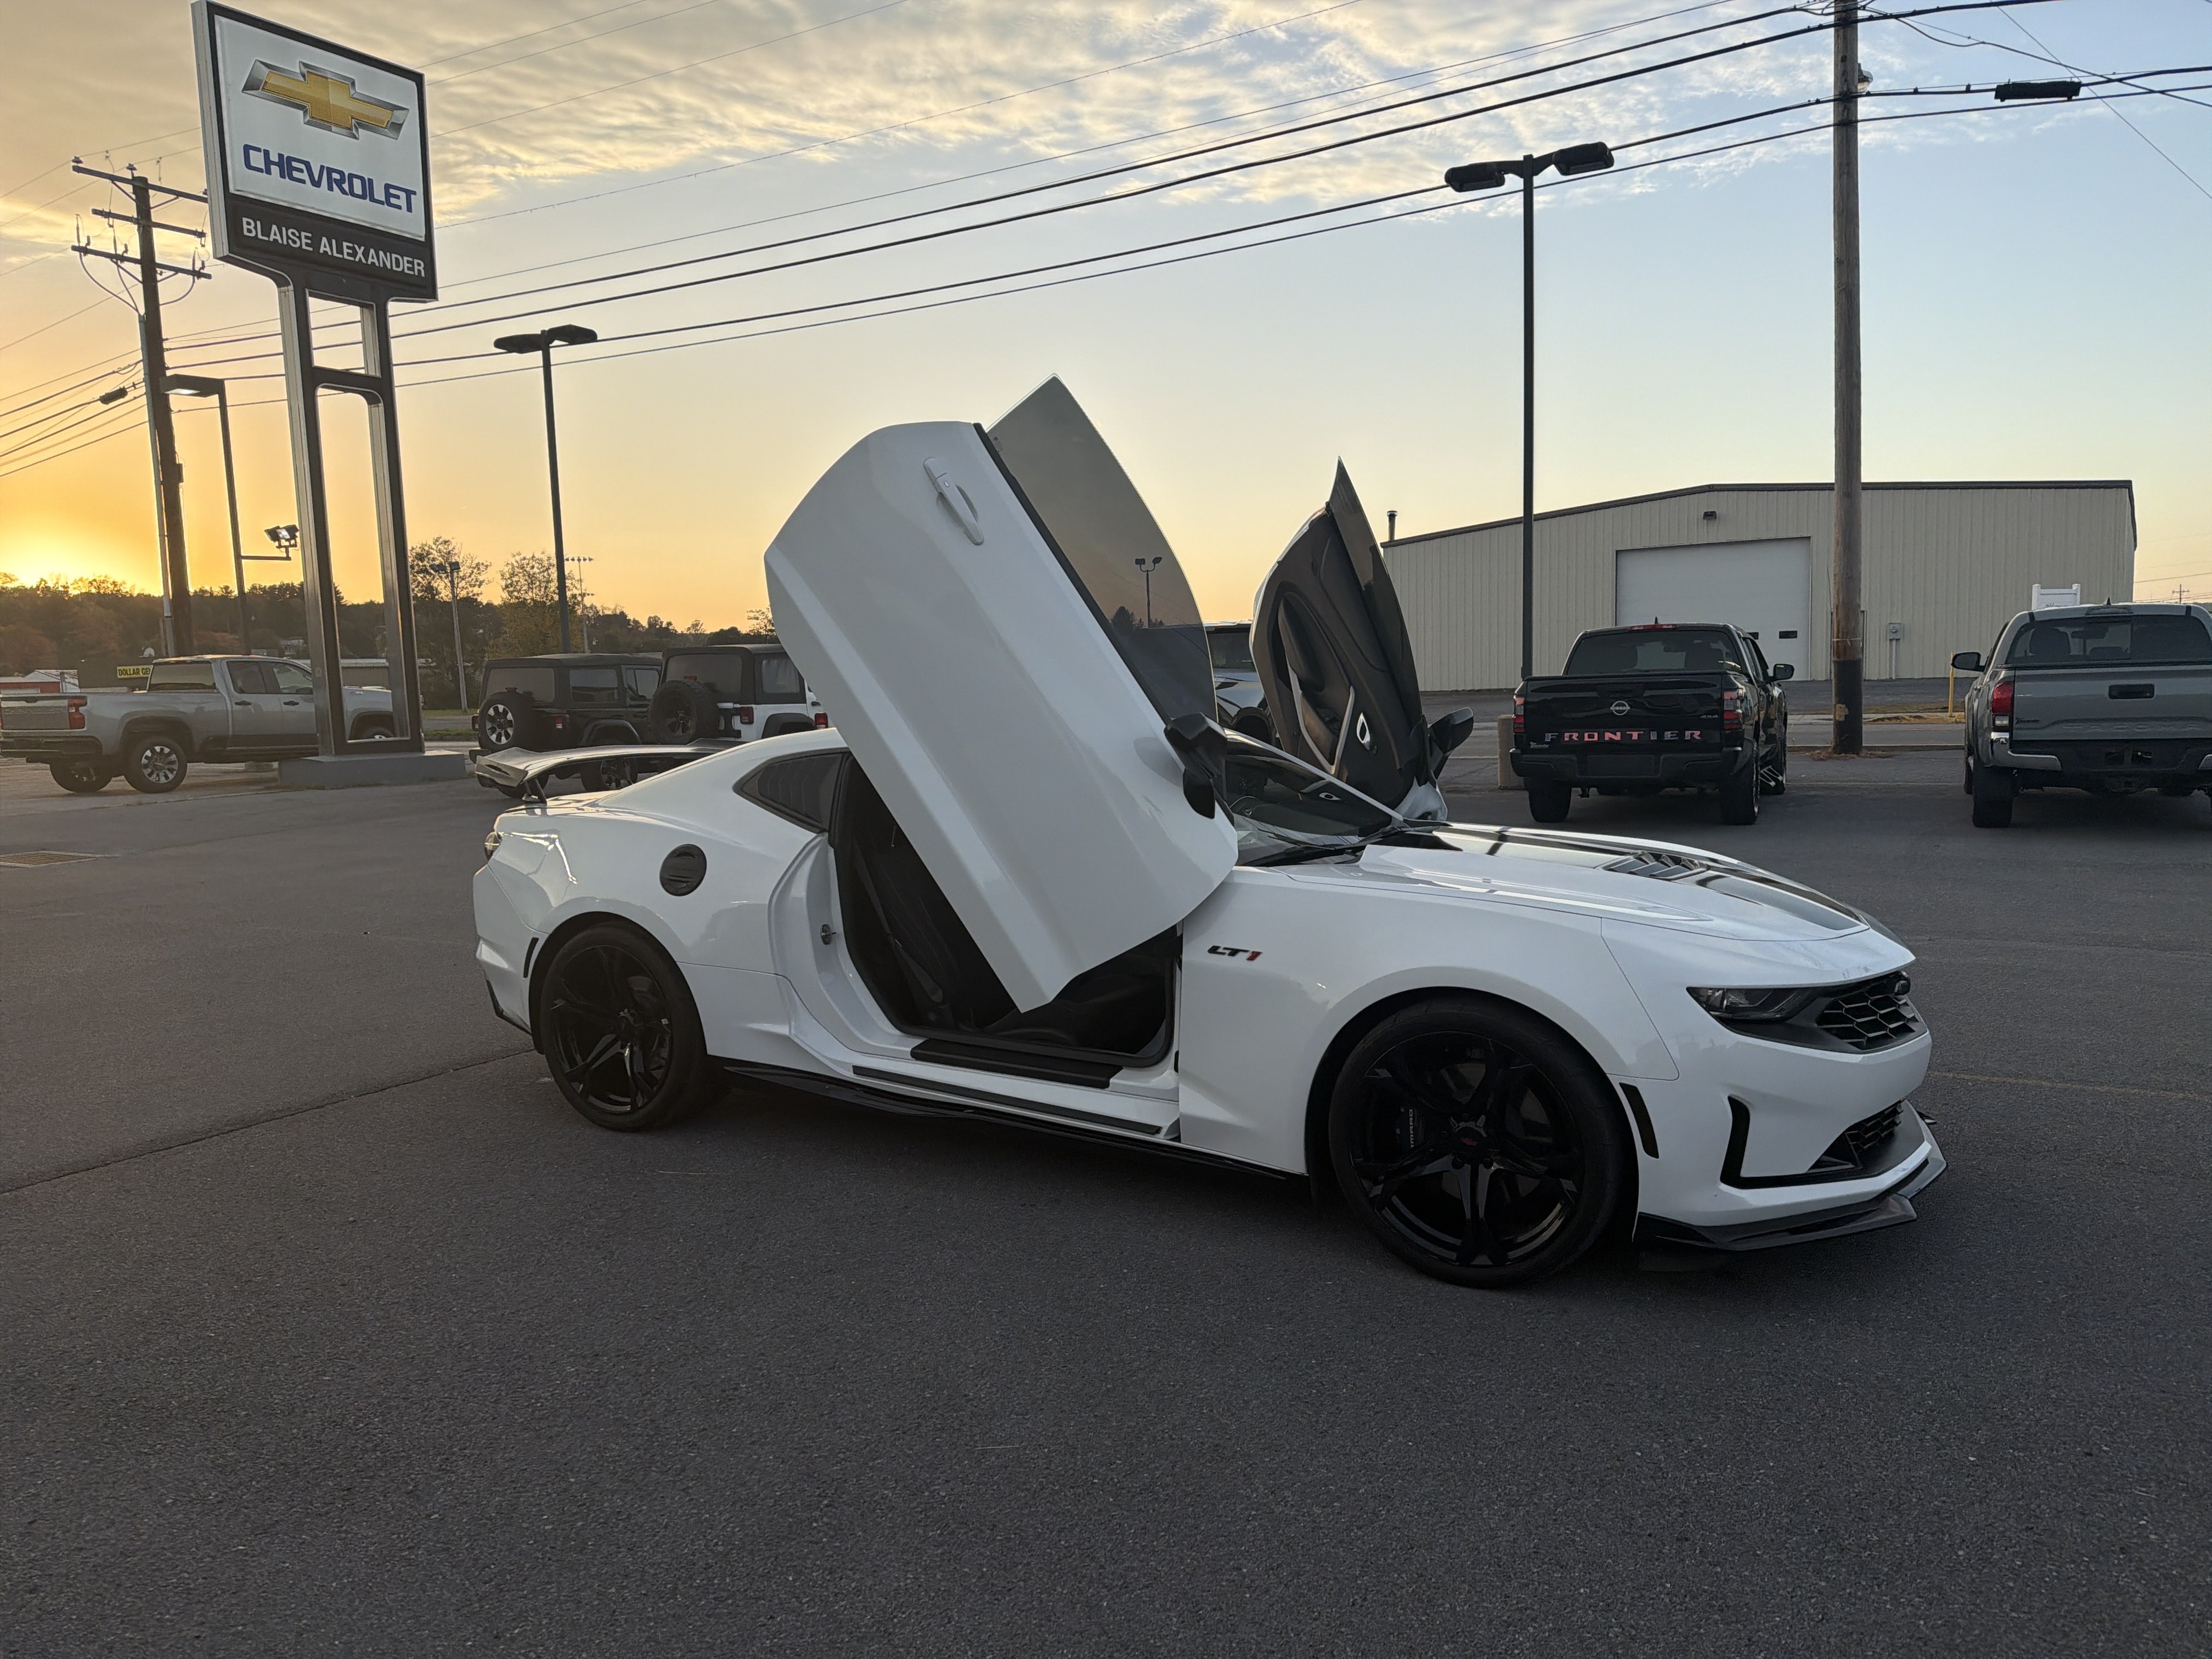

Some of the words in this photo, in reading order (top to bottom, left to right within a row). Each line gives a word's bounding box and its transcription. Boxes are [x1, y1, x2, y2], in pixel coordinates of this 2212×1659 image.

[242, 143, 417, 213] CHEVROLET
[242, 217, 313, 252] BLAISE
[319, 236, 425, 278] ALEXANDER
[118, 668, 140, 676] DOLLAR
[1544, 730, 1701, 742] FRONTIER
[1207, 945, 1262, 961] LT1
